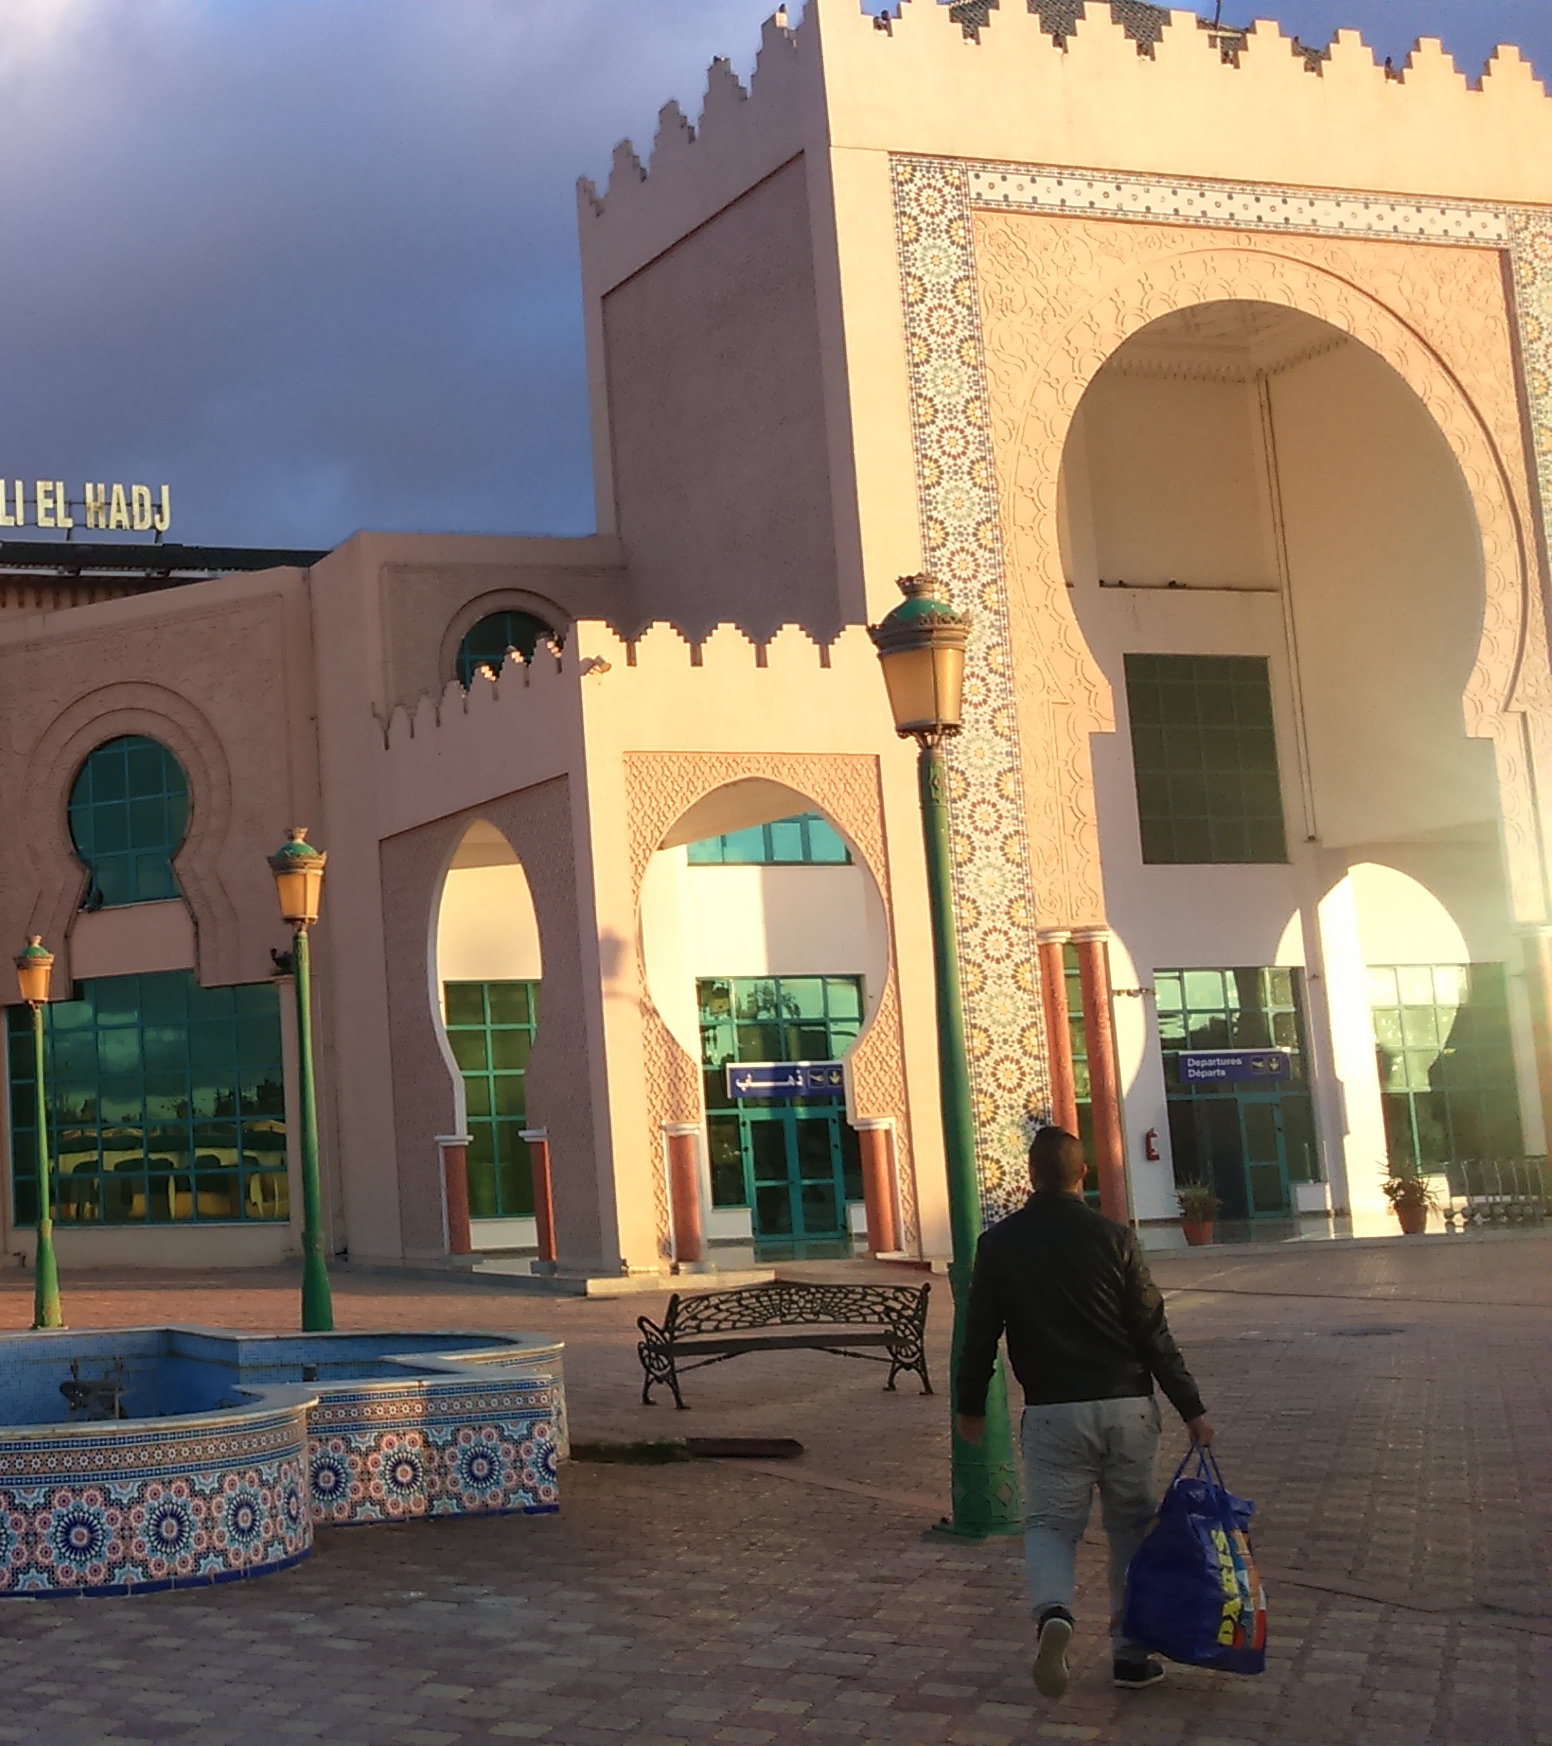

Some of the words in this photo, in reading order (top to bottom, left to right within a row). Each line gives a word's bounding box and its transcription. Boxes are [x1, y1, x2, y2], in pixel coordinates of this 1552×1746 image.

[36, 480, 74, 529] EL
[85, 482, 170, 533] HADJ
[1187, 1058, 1243, 1068] Departures
